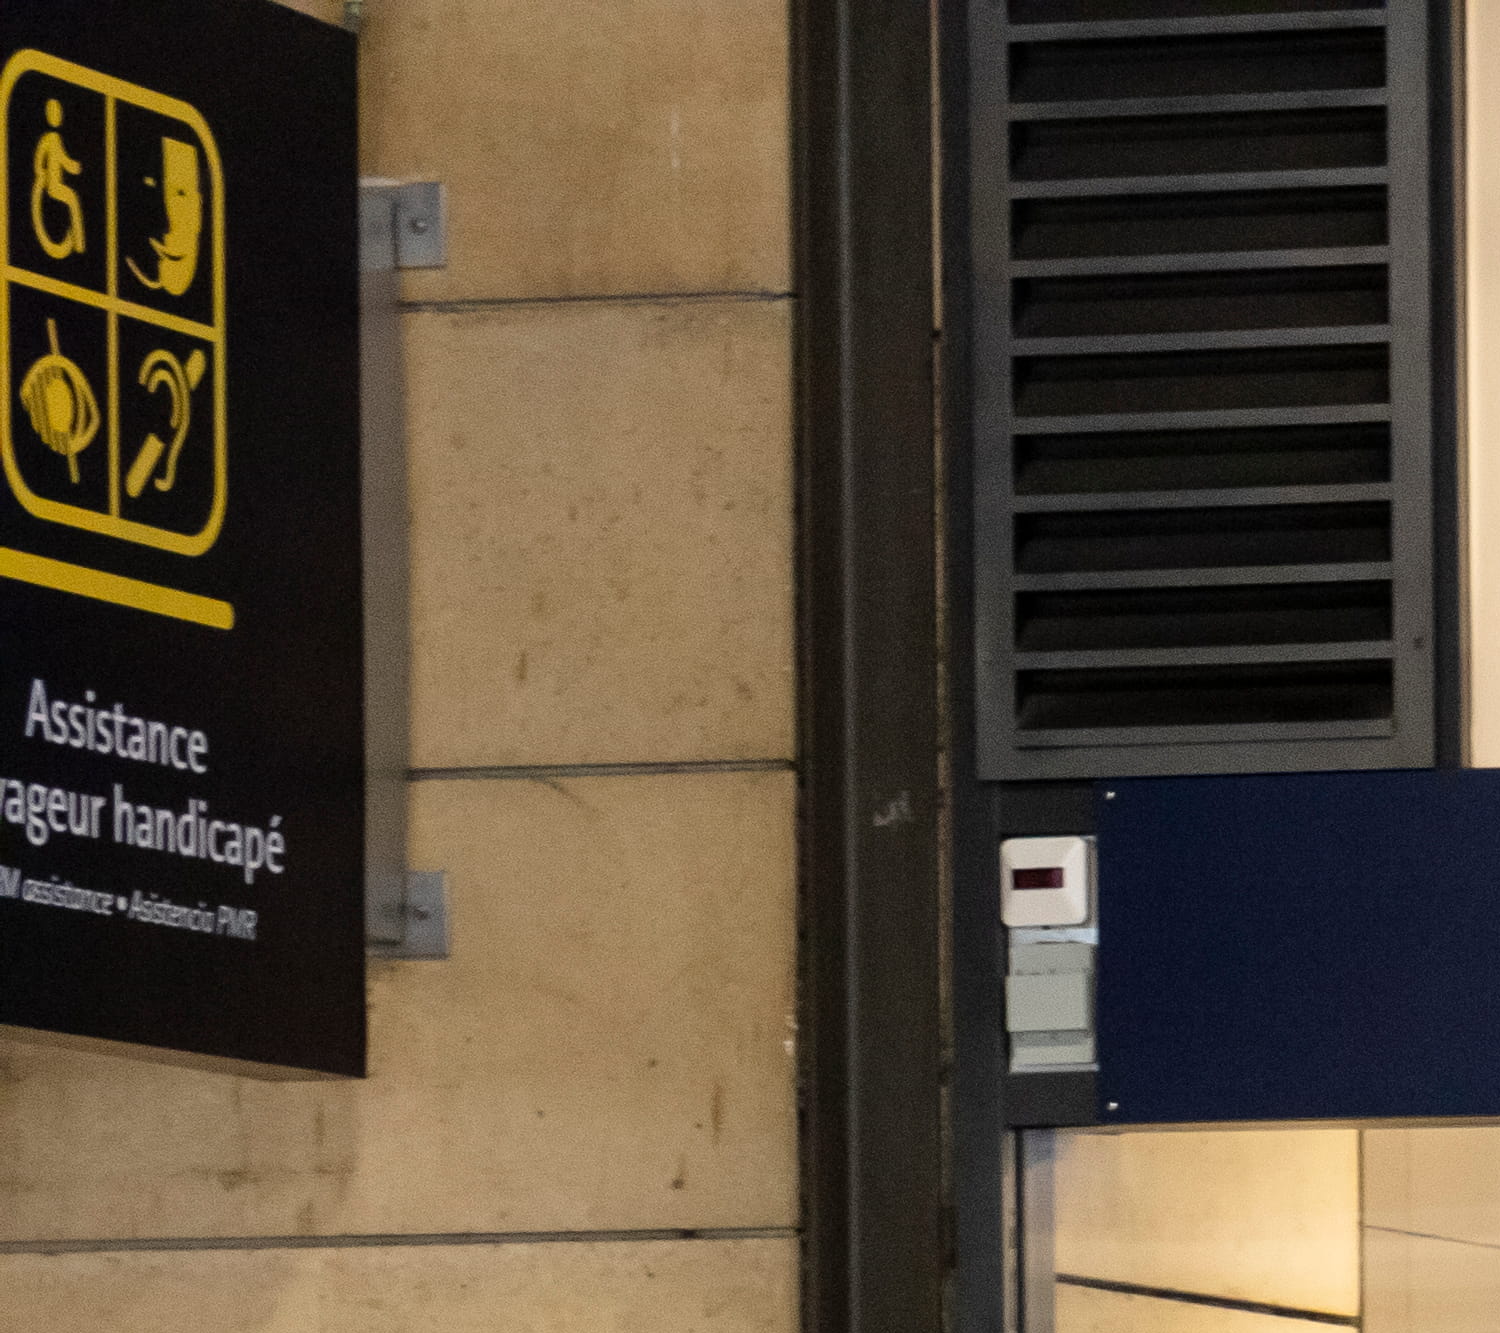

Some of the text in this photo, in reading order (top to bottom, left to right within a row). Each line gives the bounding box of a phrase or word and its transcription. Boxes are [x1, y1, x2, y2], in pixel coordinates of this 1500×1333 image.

[25, 678, 209, 774] Assistance
[0, 777, 286, 885] ageur handicapé
[22, 875, 114, 915] assistance
[216, 904, 258, 941] PMR
